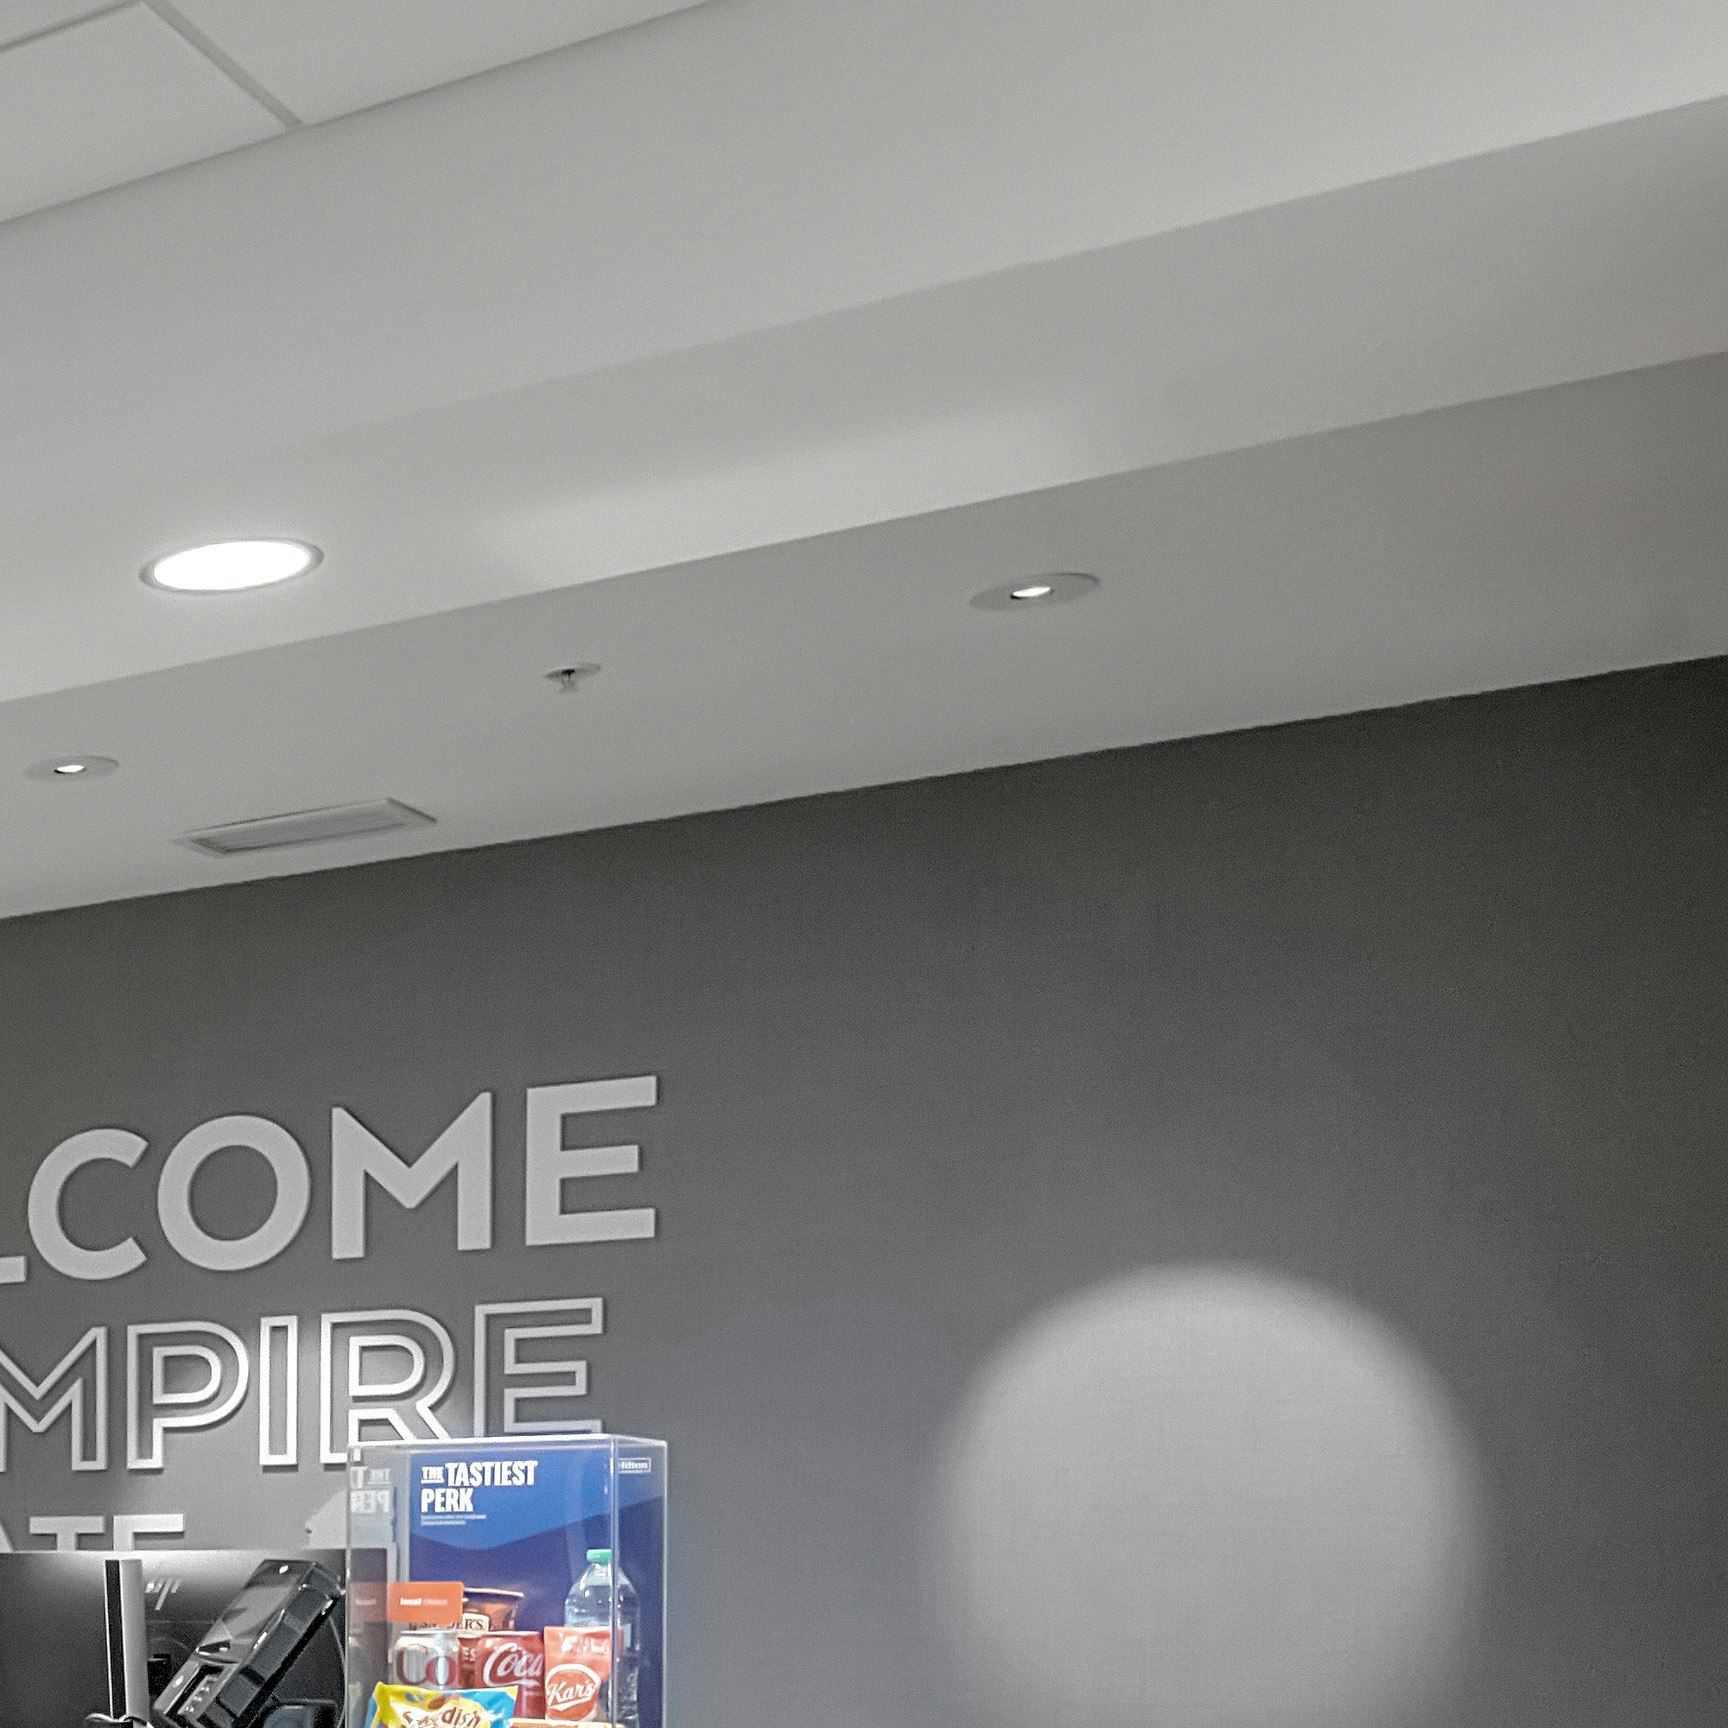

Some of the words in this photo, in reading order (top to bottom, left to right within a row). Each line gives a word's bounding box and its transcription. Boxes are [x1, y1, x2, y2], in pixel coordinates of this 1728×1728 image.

[445, 1461, 538, 1487] TASTIEST
[421, 1488, 474, 1512] PERK
[546, 1680, 594, 1707] Kar's
